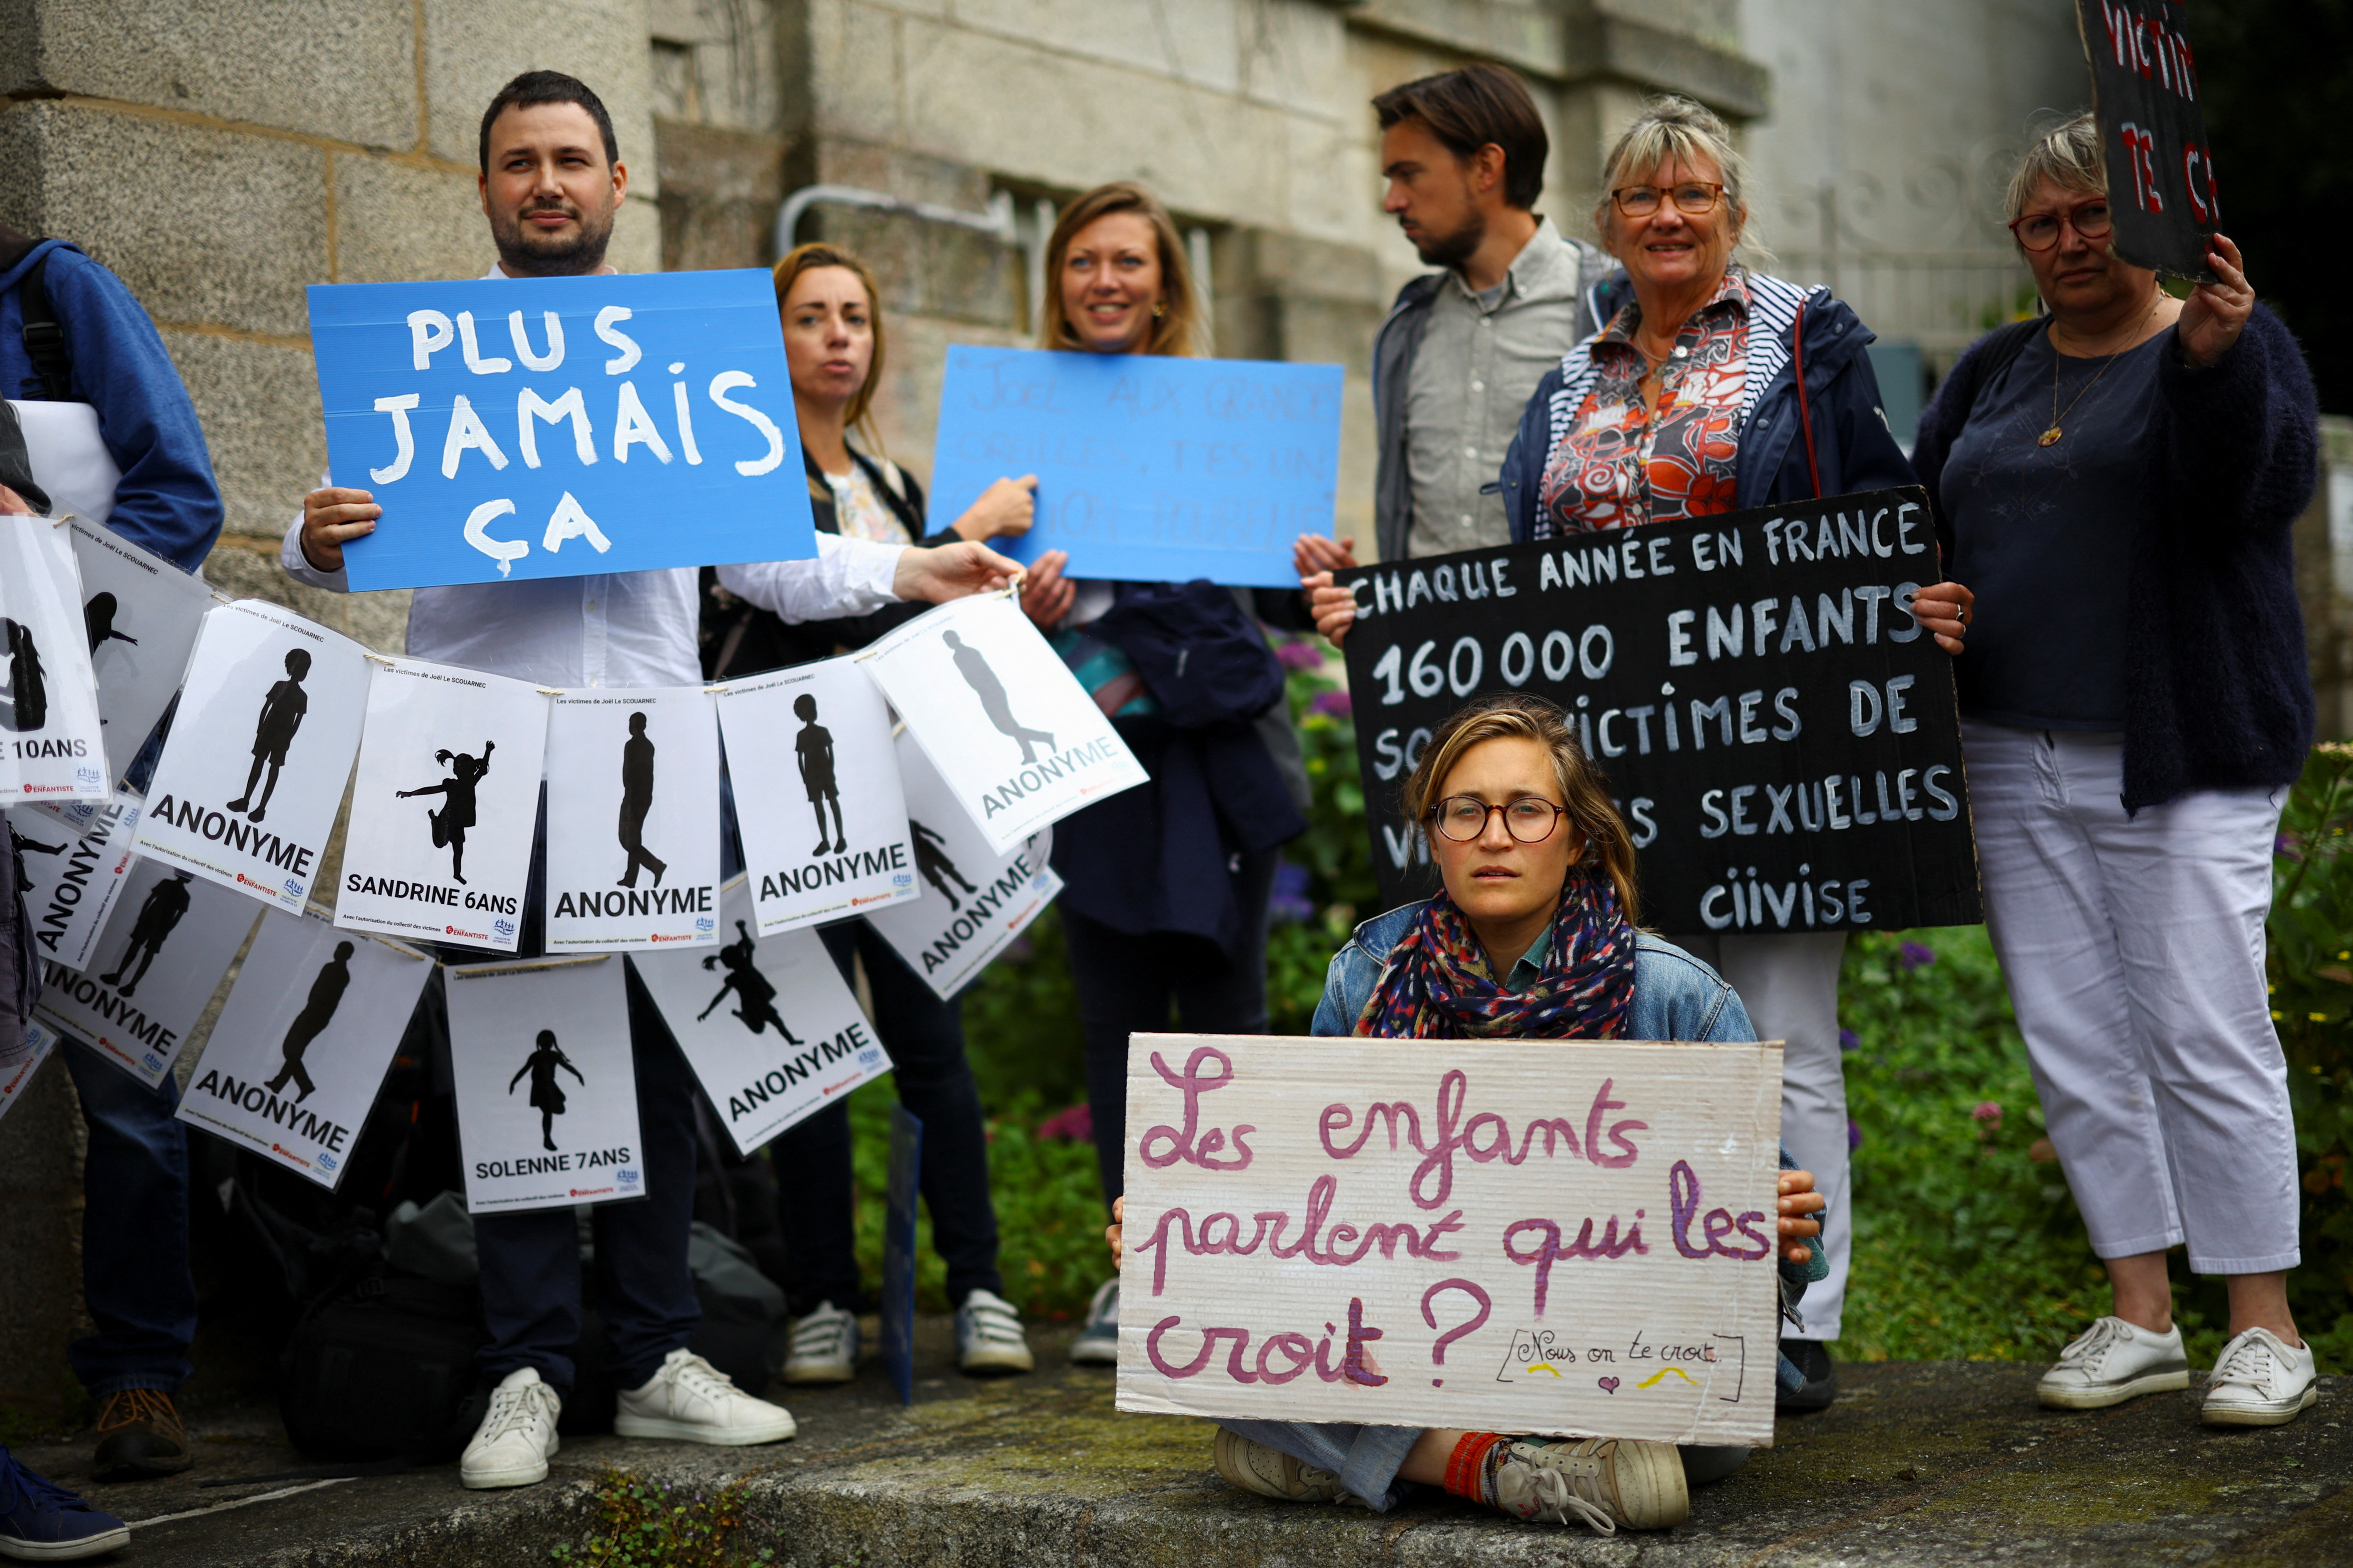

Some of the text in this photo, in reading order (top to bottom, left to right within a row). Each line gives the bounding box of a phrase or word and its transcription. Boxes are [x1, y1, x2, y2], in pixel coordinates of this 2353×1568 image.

[407, 305, 642, 375] PLUS
[71, 524, 94, 539] victimes
[103, 541, 116, 550] Joël
[123, 552, 158, 574] SCOUARNEC
[463, 490, 612, 578] ÇA
[1349, 502, 1926, 619] CHAQUE ANNÉE EN FRANCE
[235, 606, 259, 617] victimes
[290, 624, 324, 642] SCOUARNEC
[1668, 580, 1923, 667] ENFANTS
[396, 669, 420, 677] victimes
[451, 677, 486, 688] SCOUARNEC
[784, 674, 814, 684] SCOUARNEC
[1849, 674, 1918, 738] DE
[12, 739, 87, 759] 10ANS
[981, 736, 1118, 820] ANONYME
[150, 794, 314, 878] ANONYME
[1700, 764, 1960, 839] SEXUELLES
[36, 804, 124, 953] ANONYME
[152, 844, 181, 858] l'autorisation
[188, 858, 206, 867] collectif
[215, 868, 232, 877] victimes
[243, 879, 277, 896] ENFANTISTE
[347, 873, 517, 915] SANDRINE 6ANS
[554, 886, 713, 918] ANONYME
[759, 843, 907, 902] ANONYME
[356, 916, 385, 924] l'autorisation
[453, 929, 489, 940] ENFANTISTE
[921, 854, 1033, 974] ANONYME
[729, 1022, 870, 1122] ANONYME
[196, 1069, 349, 1154] ANONYME
[1139, 1046, 1648, 1210] Les enfants
[476, 1148, 630, 1179] SOLENNE 7ANS
[1135, 1160, 1771, 1322] parlent qui les
[1146, 1297, 1389, 1388] croit
[1588, 1347, 1616, 1362] on
[1629, 1330, 1654, 1358] te
